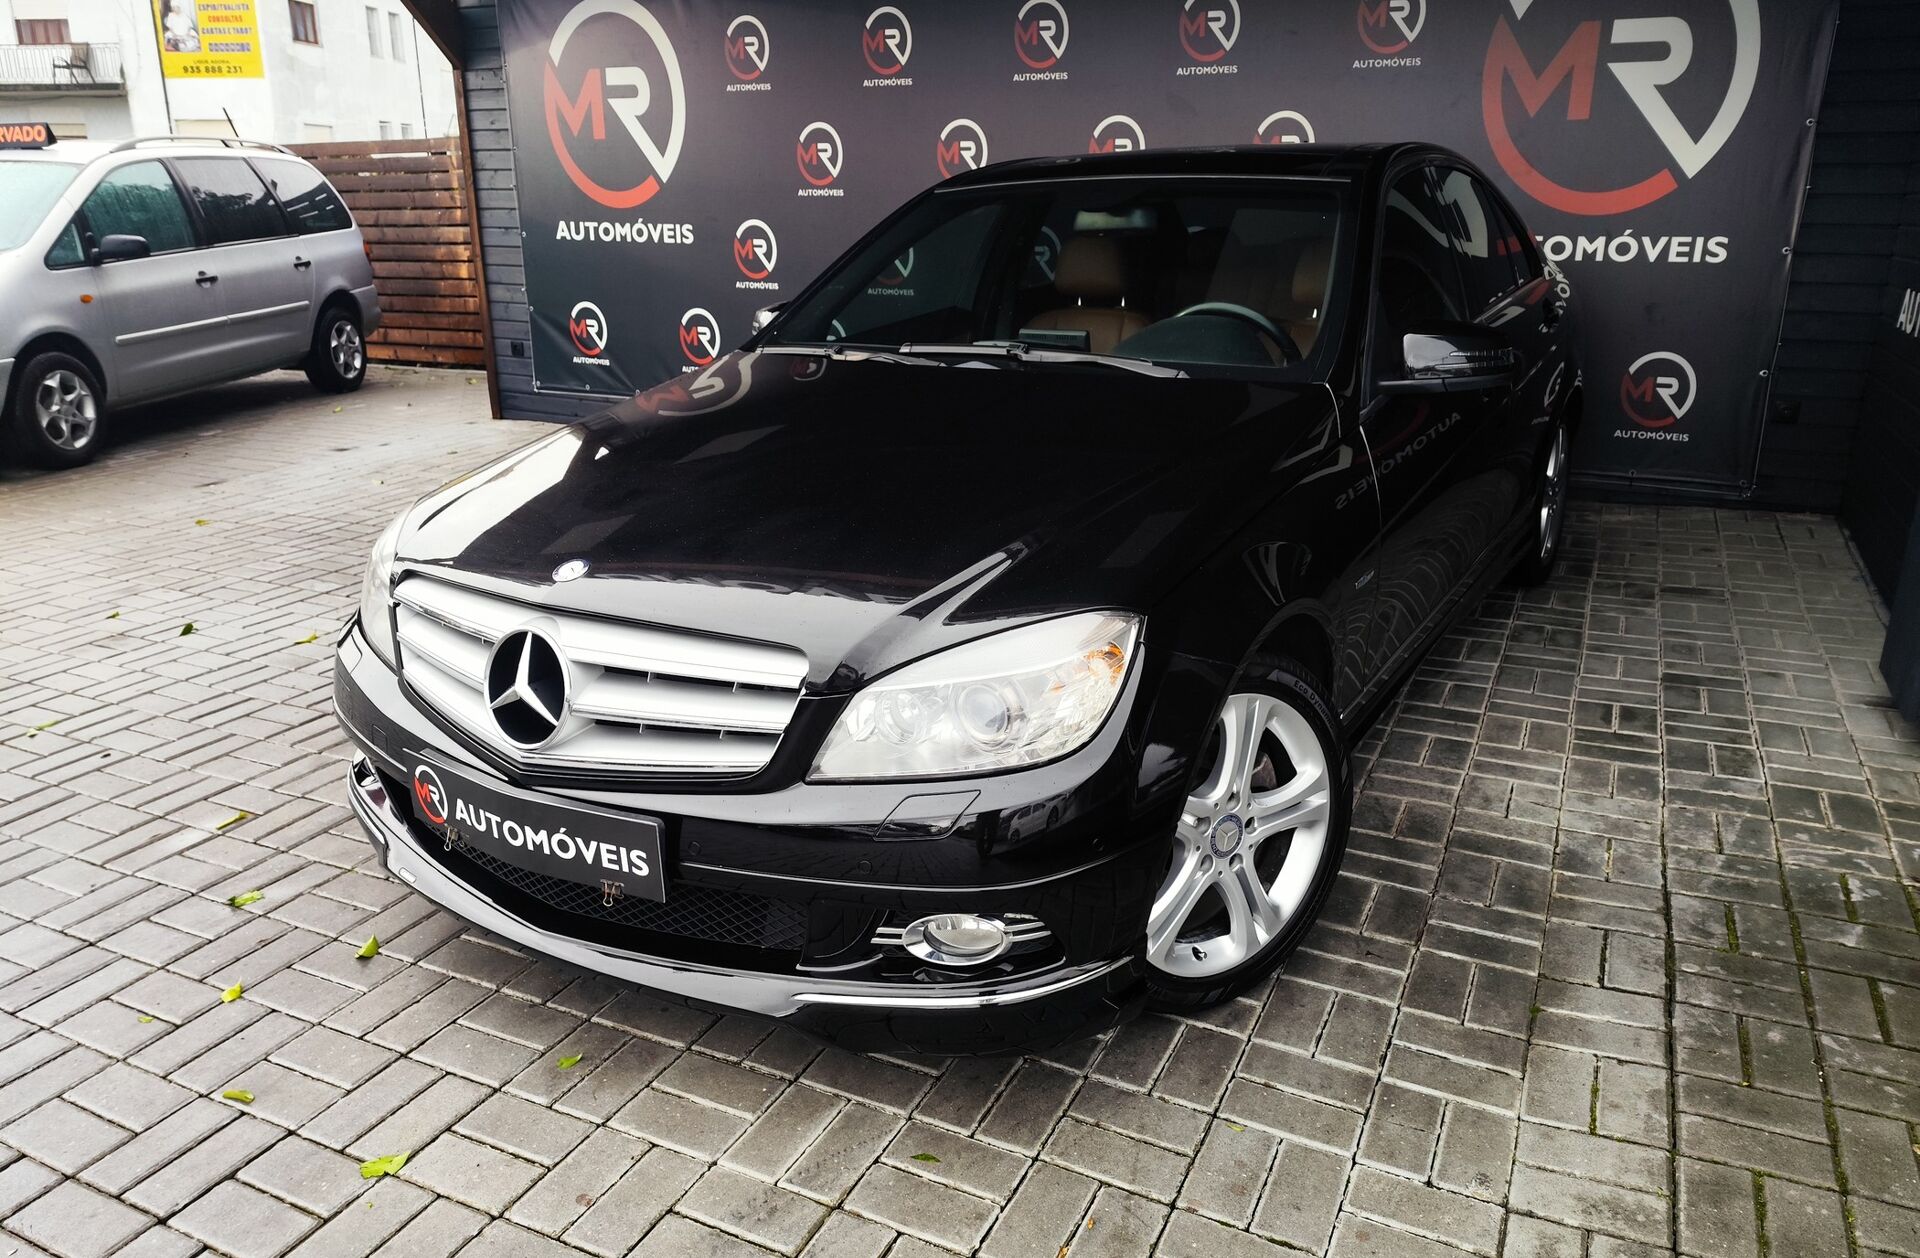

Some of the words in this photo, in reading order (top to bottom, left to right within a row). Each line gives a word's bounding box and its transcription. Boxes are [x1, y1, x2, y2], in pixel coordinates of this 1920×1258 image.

[1352, 56, 1422, 69] AUTOMÓVEIS
[1176, 64, 1238, 76] AUTOMÓVEIS
[862, 77, 913, 87] AUTOMÓVEIS
[1013, 71, 1069, 82] AUTOMÓVEIS
[726, 82, 772, 92] AUTOMÓVEIS
[797, 187, 844, 197] AUTOMÓVEIS
[556, 217, 694, 245] AUTOMÓVEIS
[1535, 229, 1729, 264] OMÓVEIS
[735, 280, 780, 290] AUTOMÓVEIS
[867, 287, 915, 297] AUTOMÓVEIS
[1613, 429, 1690, 442] AUTOMÓVEIS
[455, 798, 650, 876] AUTOMÓVEIS
